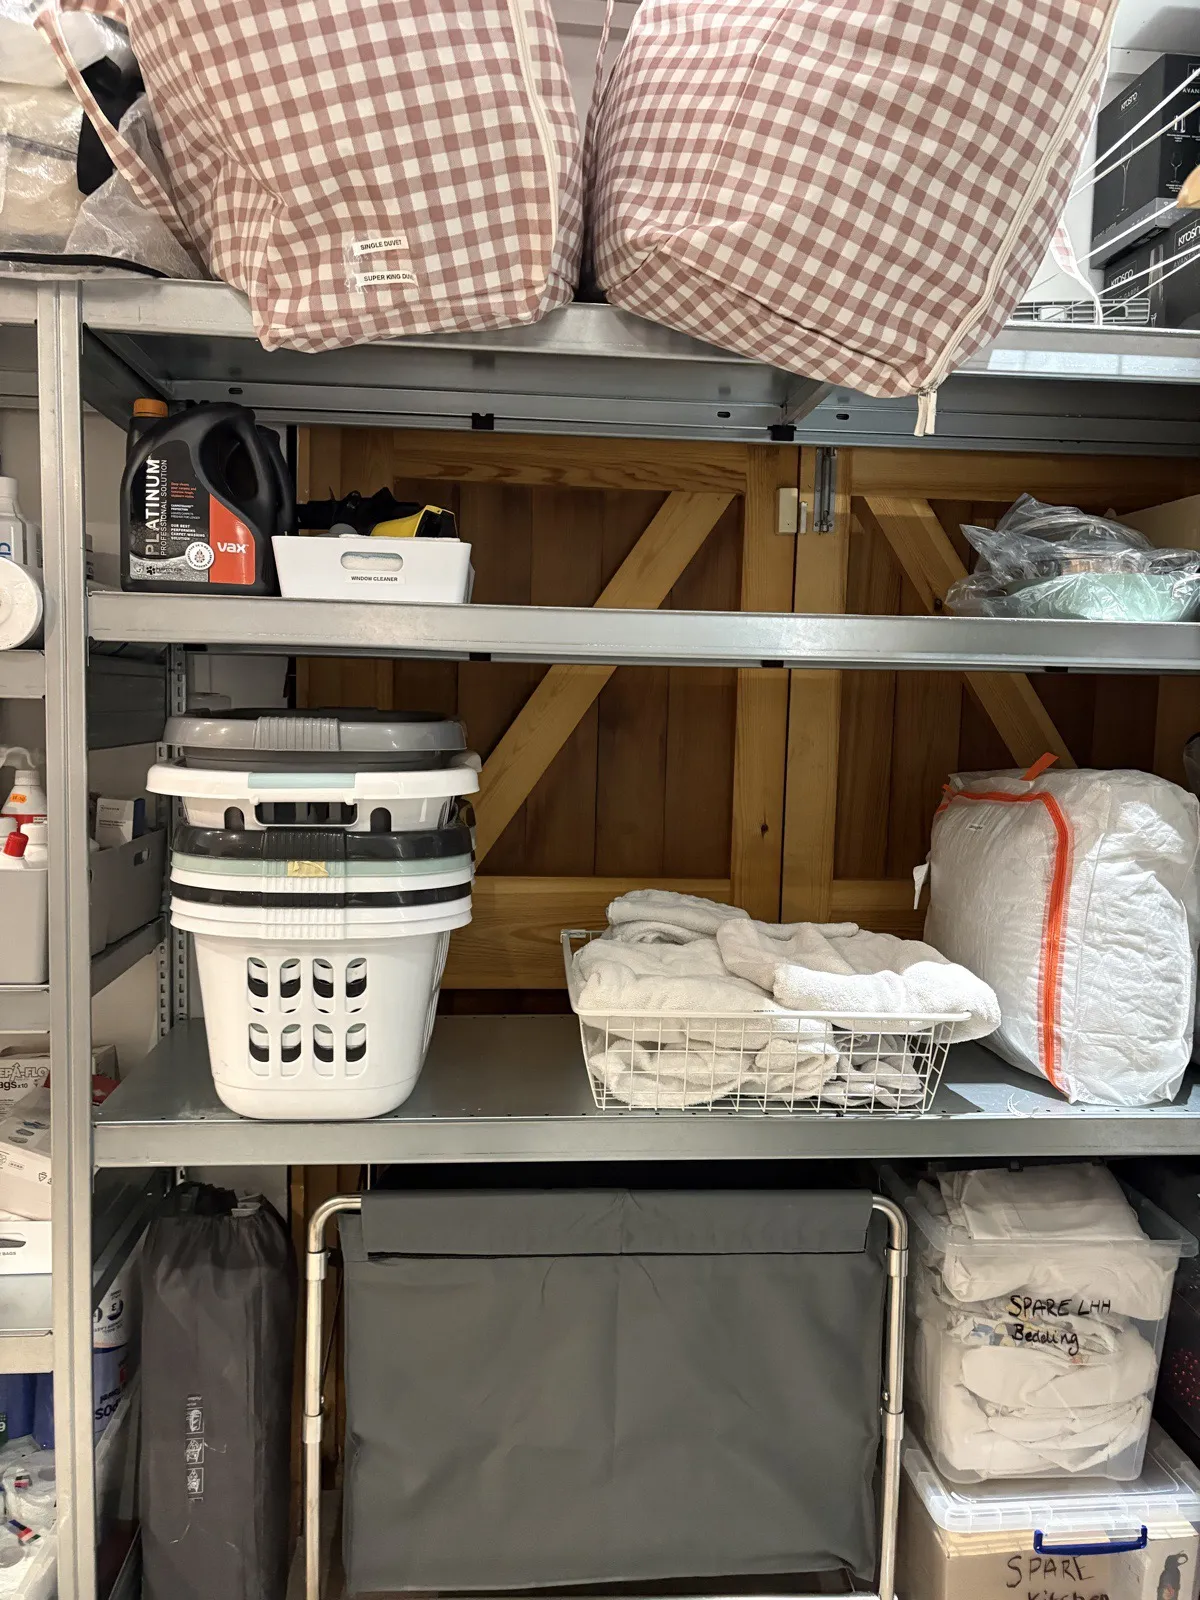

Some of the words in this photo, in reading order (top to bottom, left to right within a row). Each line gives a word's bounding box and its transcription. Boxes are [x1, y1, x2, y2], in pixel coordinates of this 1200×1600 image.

[360, 242, 383, 251] SINGLE
[384, 239, 402, 247] DUVET
[363, 274, 385, 282] SUPER
[386, 273, 401, 281] KING
[160, 459, 168, 497] SOLUTION
[145, 459, 160, 556] PLATINUM
[160, 500, 168, 556] PROFESSIONAL
[217, 541, 246, 554] vax
[0, 1062, 49, 1081] EPA-FLO
[1008, 1295, 1073, 1318] SPARE
[1012, 1323, 1080, 1356] Bedding
[1006, 1556, 1095, 1589] SPARE
